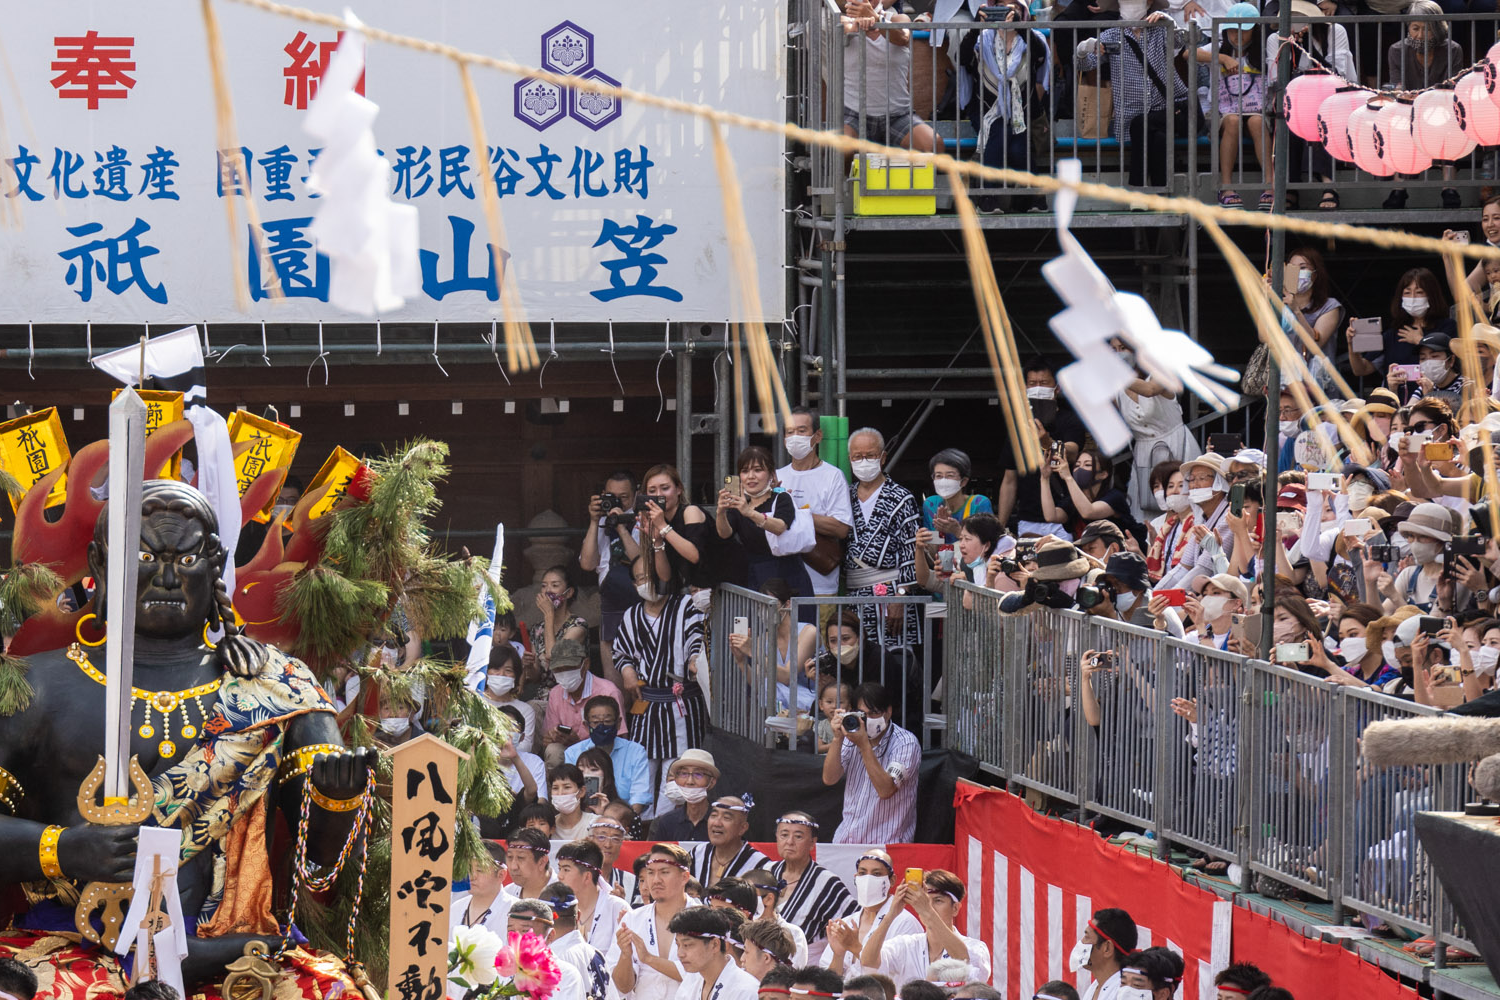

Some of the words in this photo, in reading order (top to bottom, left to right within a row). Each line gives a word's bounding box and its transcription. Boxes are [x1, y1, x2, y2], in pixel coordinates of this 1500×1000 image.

[216, 144, 654, 201] 国重形民俗文化財
